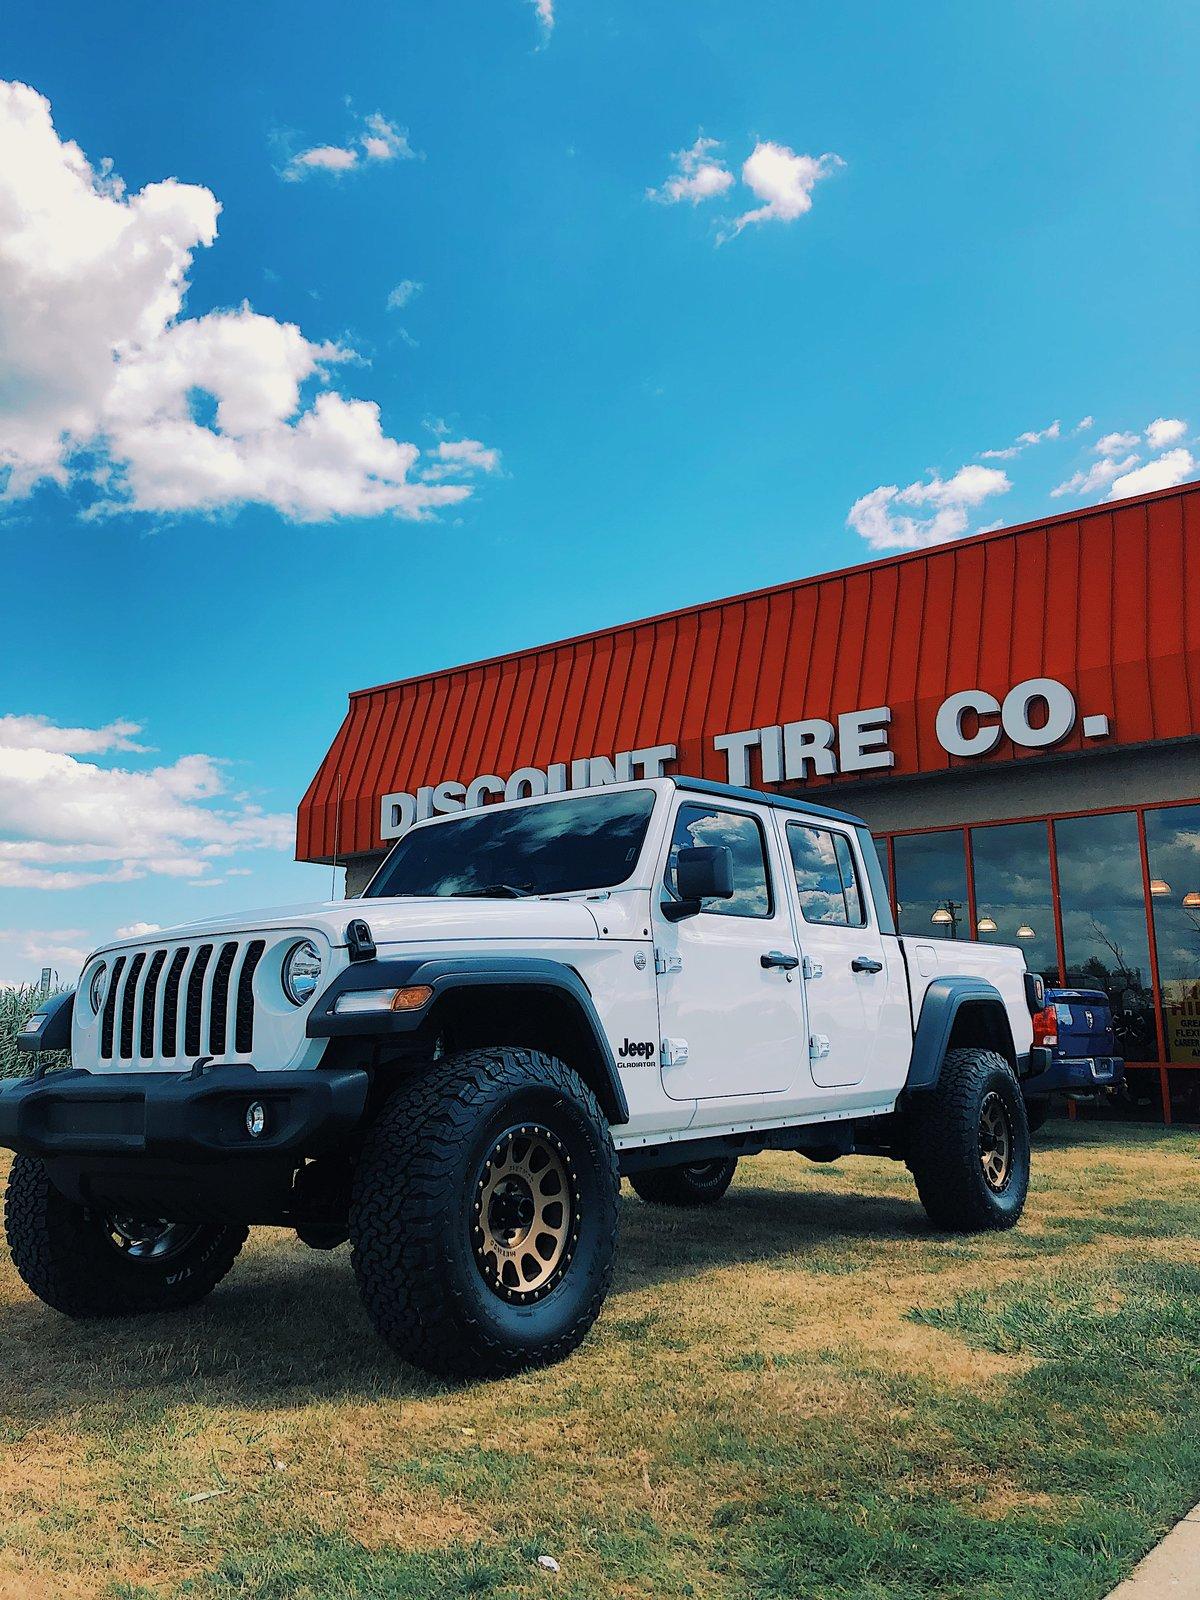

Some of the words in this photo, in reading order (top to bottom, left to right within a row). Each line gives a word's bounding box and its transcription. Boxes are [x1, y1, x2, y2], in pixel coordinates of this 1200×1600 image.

[380, 743, 677, 840] DISCOUNT
[714, 706, 895, 787] TIRE
[936, 677, 1109, 757] CO.
[618, 1037, 655, 1060] Jeep
[617, 1061, 656, 1069] GLADIATOR
